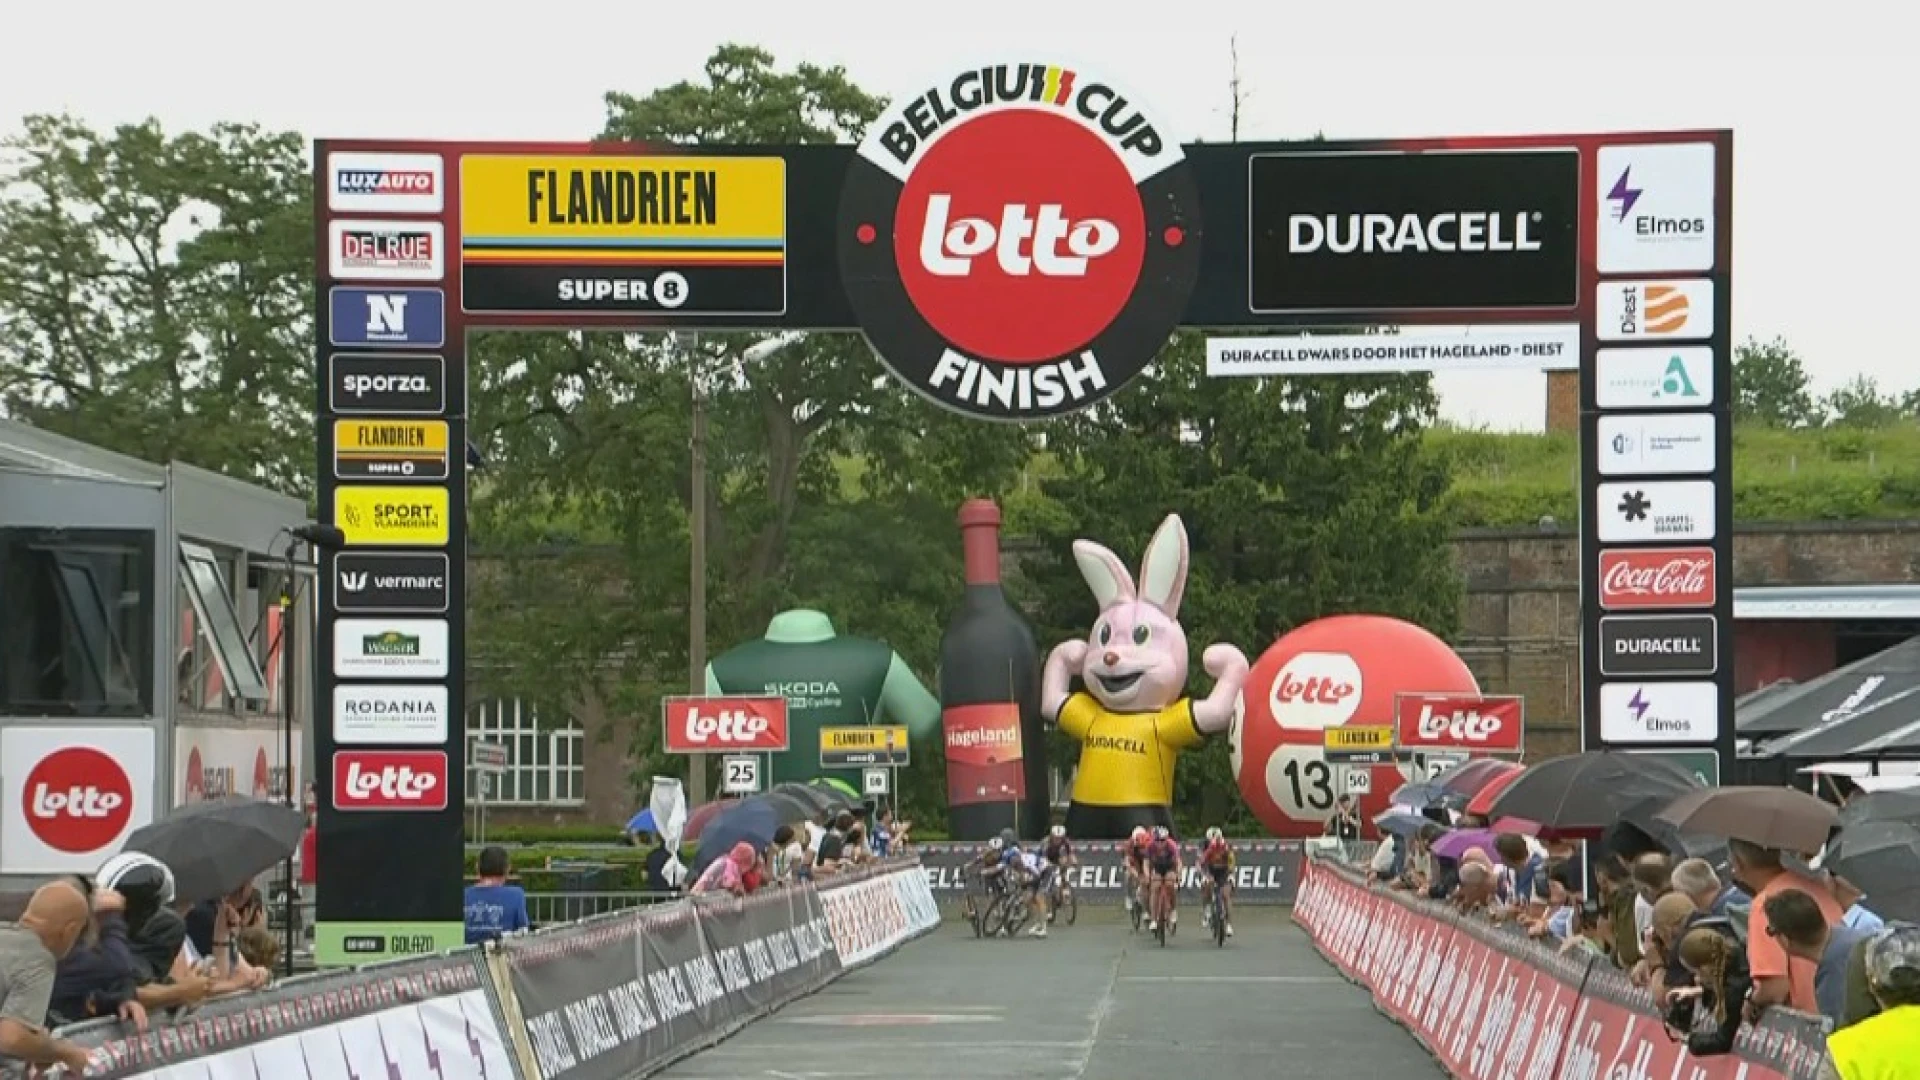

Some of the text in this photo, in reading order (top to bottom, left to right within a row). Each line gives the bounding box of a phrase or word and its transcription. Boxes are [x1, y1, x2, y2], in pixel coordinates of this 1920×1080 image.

[1076, 84, 1162, 158] CUP
[340, 173, 430, 190] LUXAUTO
[527, 169, 716, 225] FLANDRIEN
[1288, 210, 1541, 253] DURACELL
[1636, 215, 1704, 235] Elmos
[345, 235, 429, 259] DELRUE
[558, 278, 648, 302] SUPER
[366, 293, 408, 332] N
[1621, 286, 1636, 334] Diest
[1221, 348, 1295, 364] DURACELL
[1298, 347, 1350, 362] DWARS
[1353, 346, 1397, 360] DOOR
[1400, 345, 1427, 358] HET
[1429, 344, 1511, 358] HAGELAND
[1522, 342, 1564, 357] DIEST
[344, 374, 430, 397] sporza.
[929, 348, 1108, 409] FINISH
[358, 426, 424, 447] FLANDRIEN
[375, 573, 442, 589] vermarc
[1615, 637, 1701, 654] DURACELL
[345, 700, 437, 715] RODANIA
[948, 724, 1017, 747] Hageland
[1646, 717, 1691, 731] Elmos
[1085, 733, 1148, 756] DURACELL
[729, 764, 754, 783] 25
[1284, 759, 1334, 810] 13
[1350, 773, 1368, 787] 50
[391, 935, 434, 953] GOLAZO
